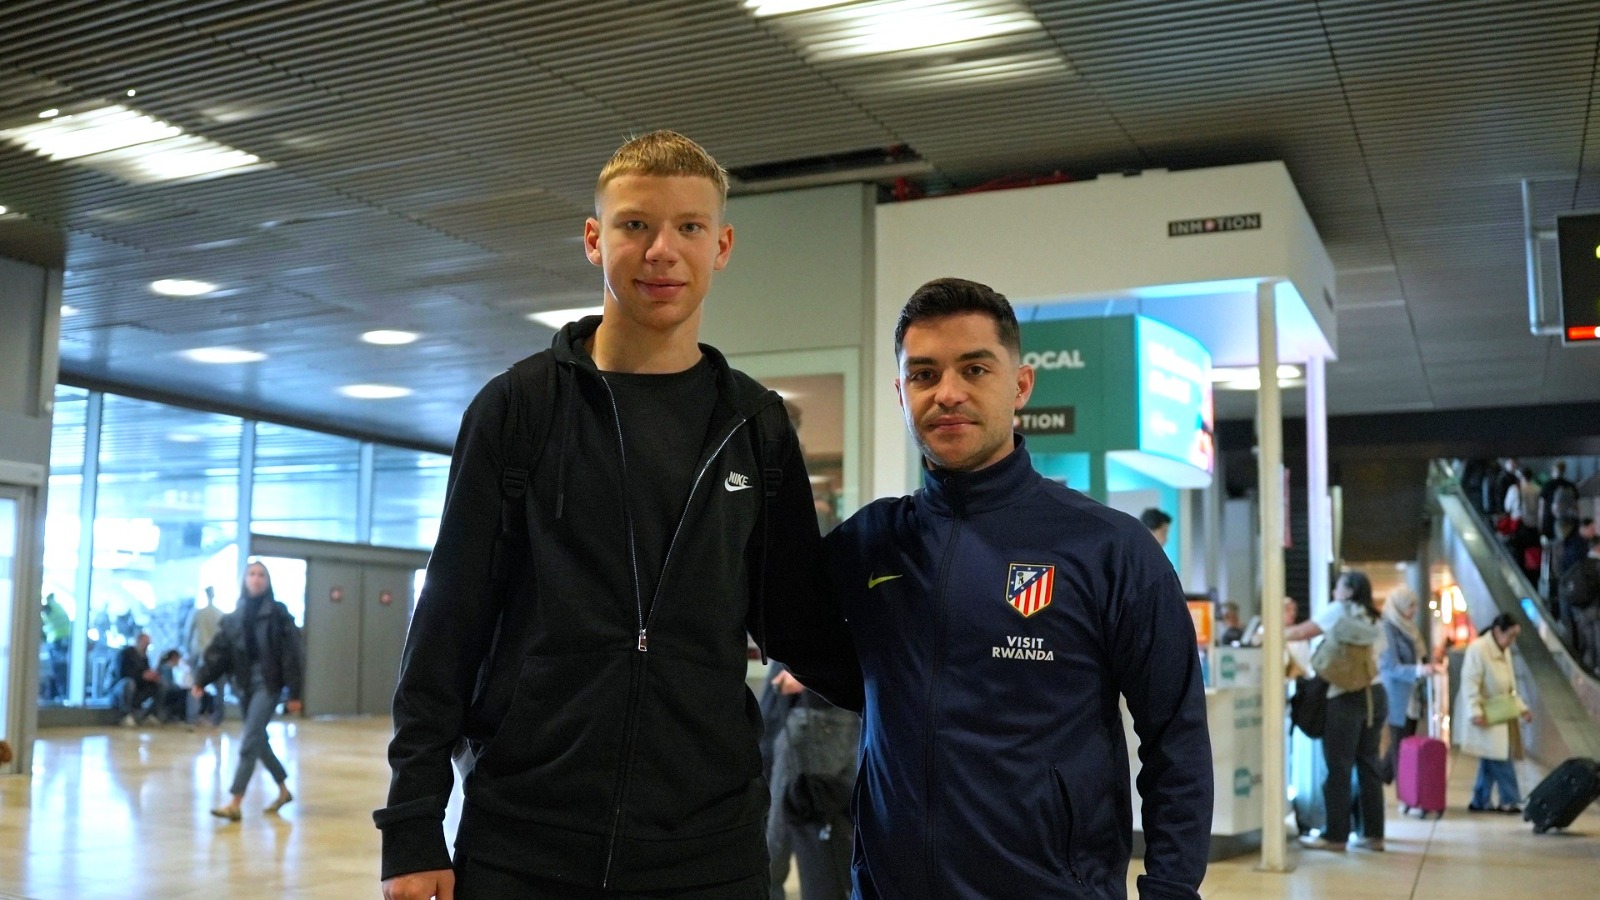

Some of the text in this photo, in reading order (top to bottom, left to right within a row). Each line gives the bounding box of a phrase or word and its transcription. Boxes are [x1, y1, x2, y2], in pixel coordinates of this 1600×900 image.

[1021, 350, 1085, 369] OCAL
[728, 471, 749, 487] NIKE
[1006, 635, 1044, 649] VISIT
[991, 646, 1055, 661] RWANDA
